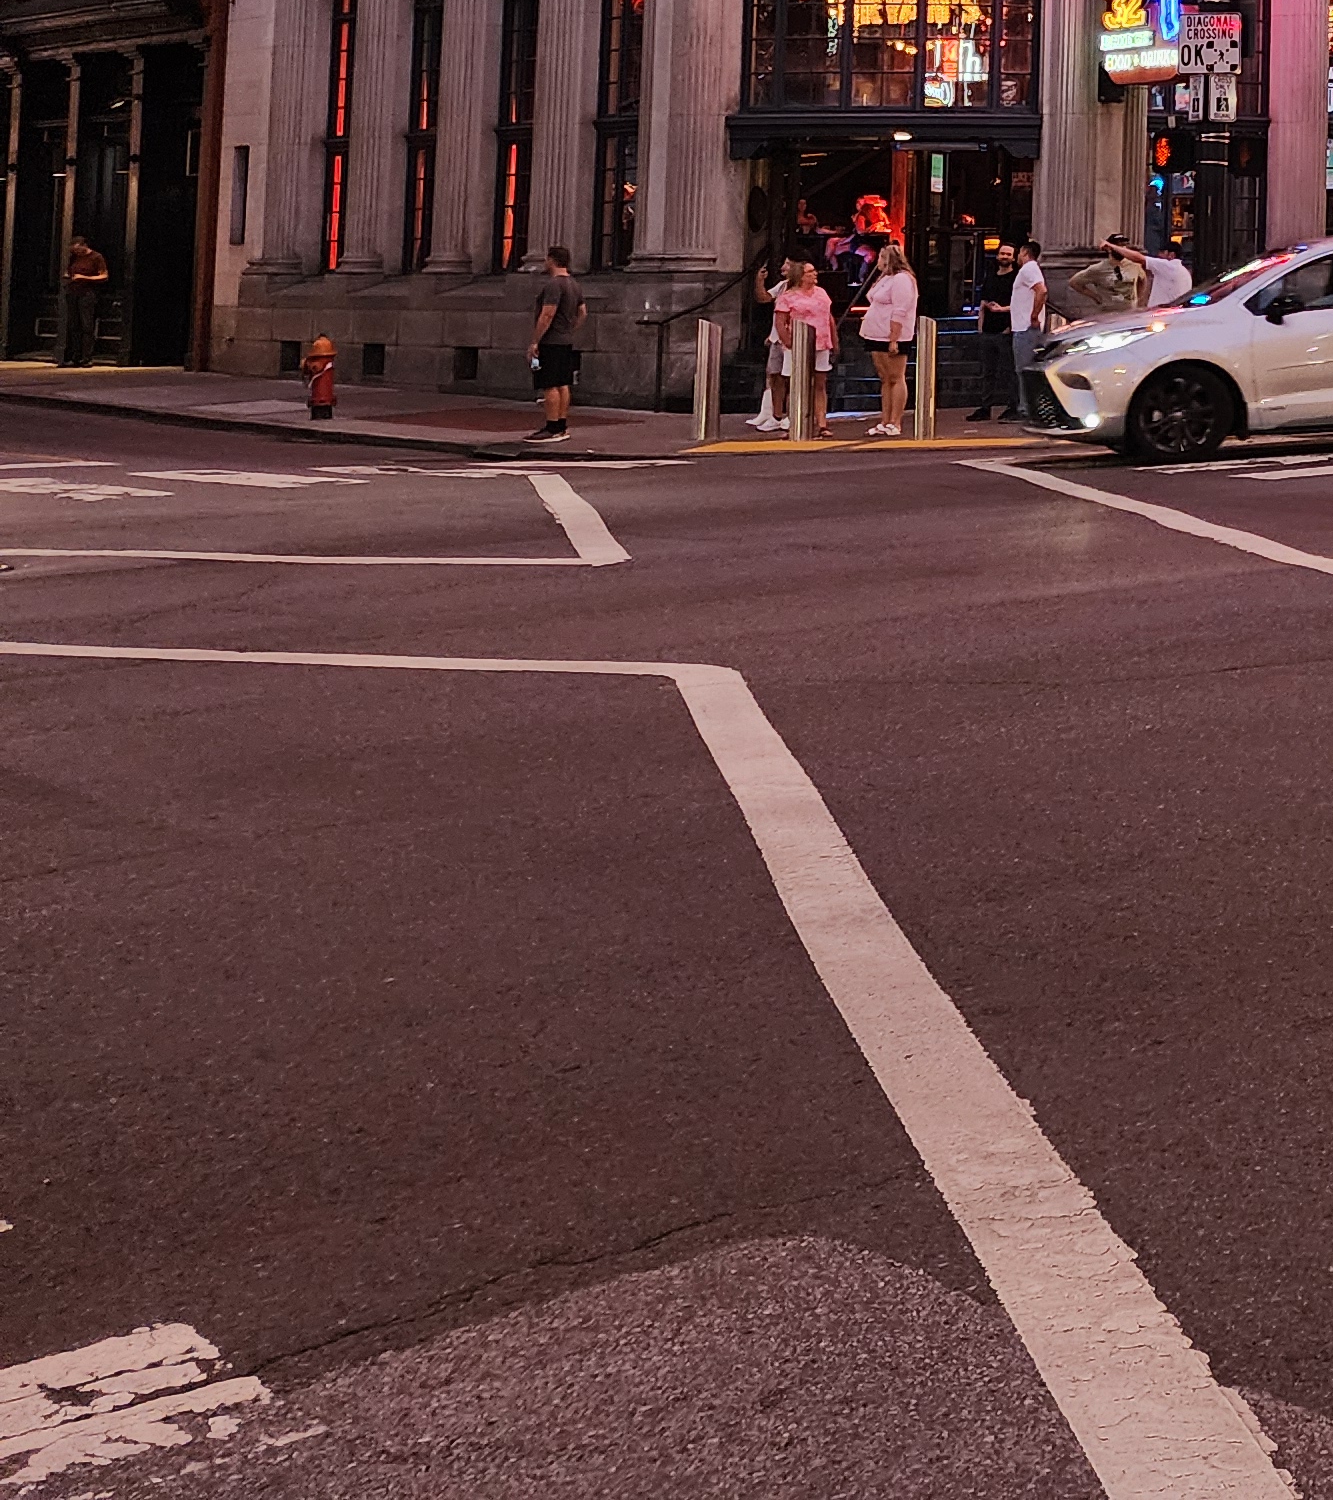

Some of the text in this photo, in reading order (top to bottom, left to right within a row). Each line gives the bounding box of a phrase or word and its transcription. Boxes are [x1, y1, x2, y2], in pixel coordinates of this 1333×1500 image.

[1186, 16, 1234, 28] DIAGONAL
[1186, 28, 1234, 40] CROSSING
[1181, 43, 1205, 67] OK
